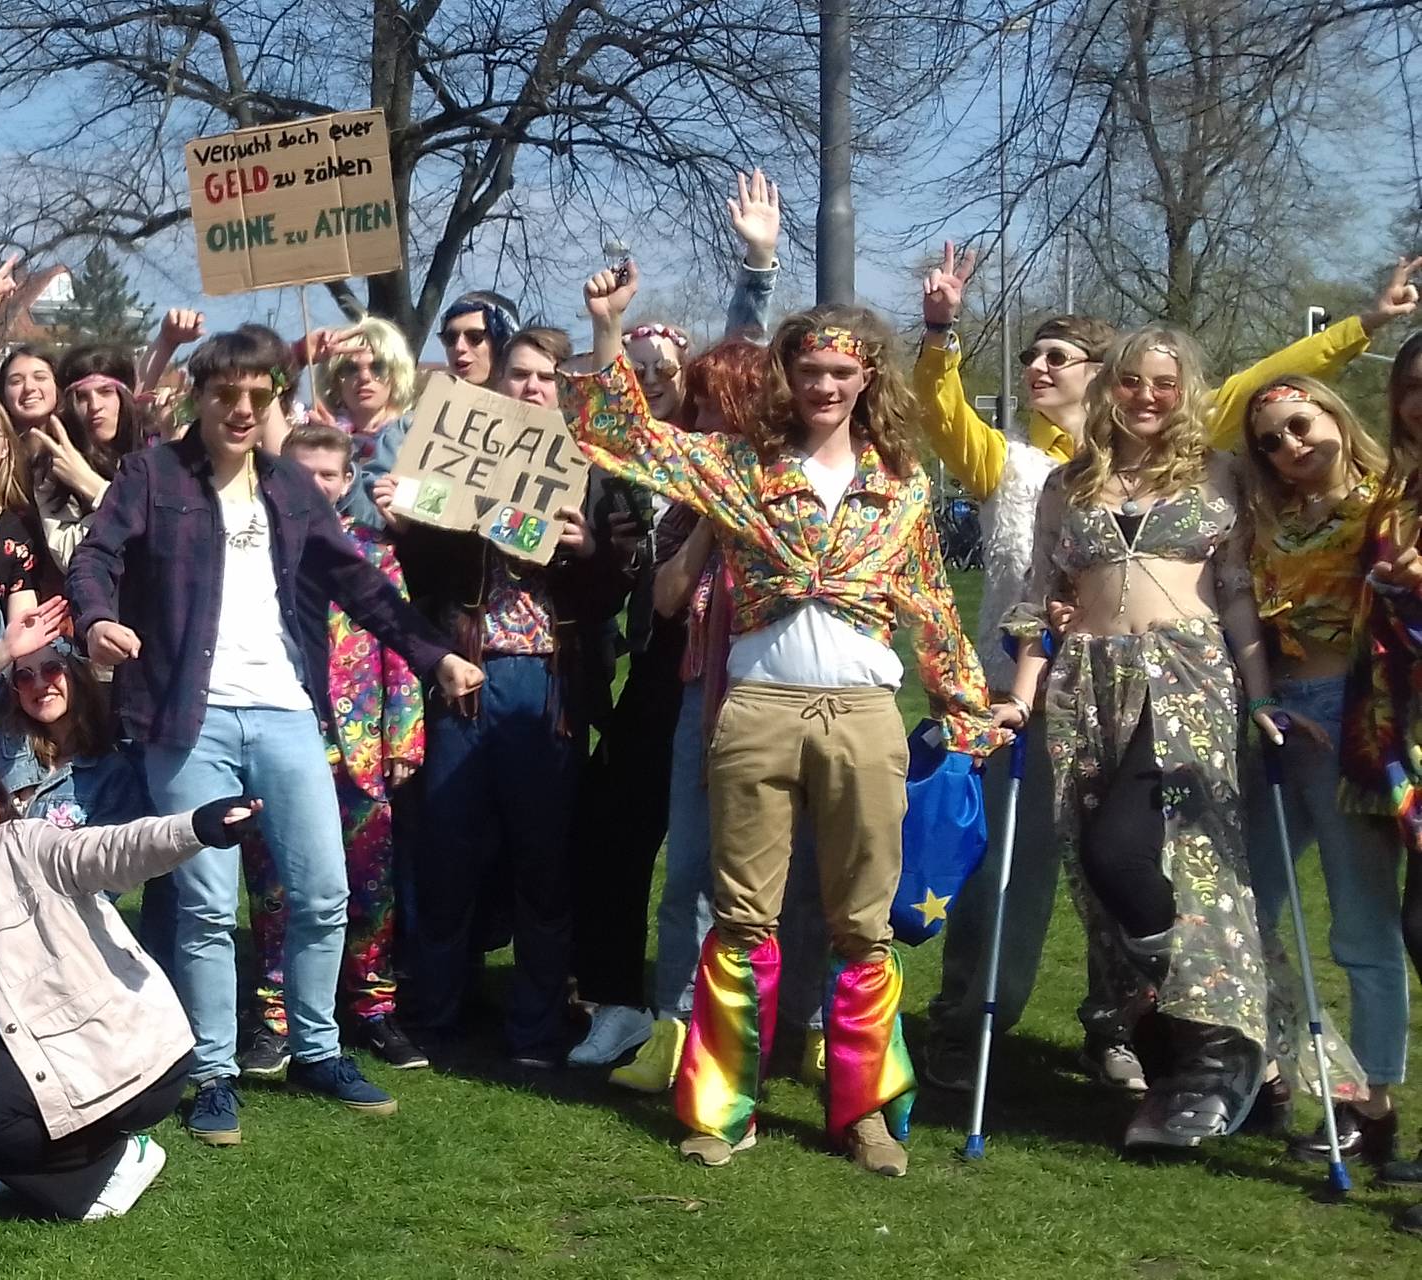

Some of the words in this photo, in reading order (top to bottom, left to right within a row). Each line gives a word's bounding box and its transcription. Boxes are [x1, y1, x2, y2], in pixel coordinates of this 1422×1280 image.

[277, 127, 319, 149] doch
[329, 120, 374, 141] euer
[204, 165, 270, 204] GELD
[273, 171, 296, 189] zu
[304, 156, 373, 185] zählen
[206, 213, 278, 253] OHNE
[283, 229, 308, 246] zu
[314, 200, 393, 239] ATMEN
[432, 400, 587, 474] LEGAL-
[418, 440, 498, 490] IZE
[510, 471, 570, 514] IT
